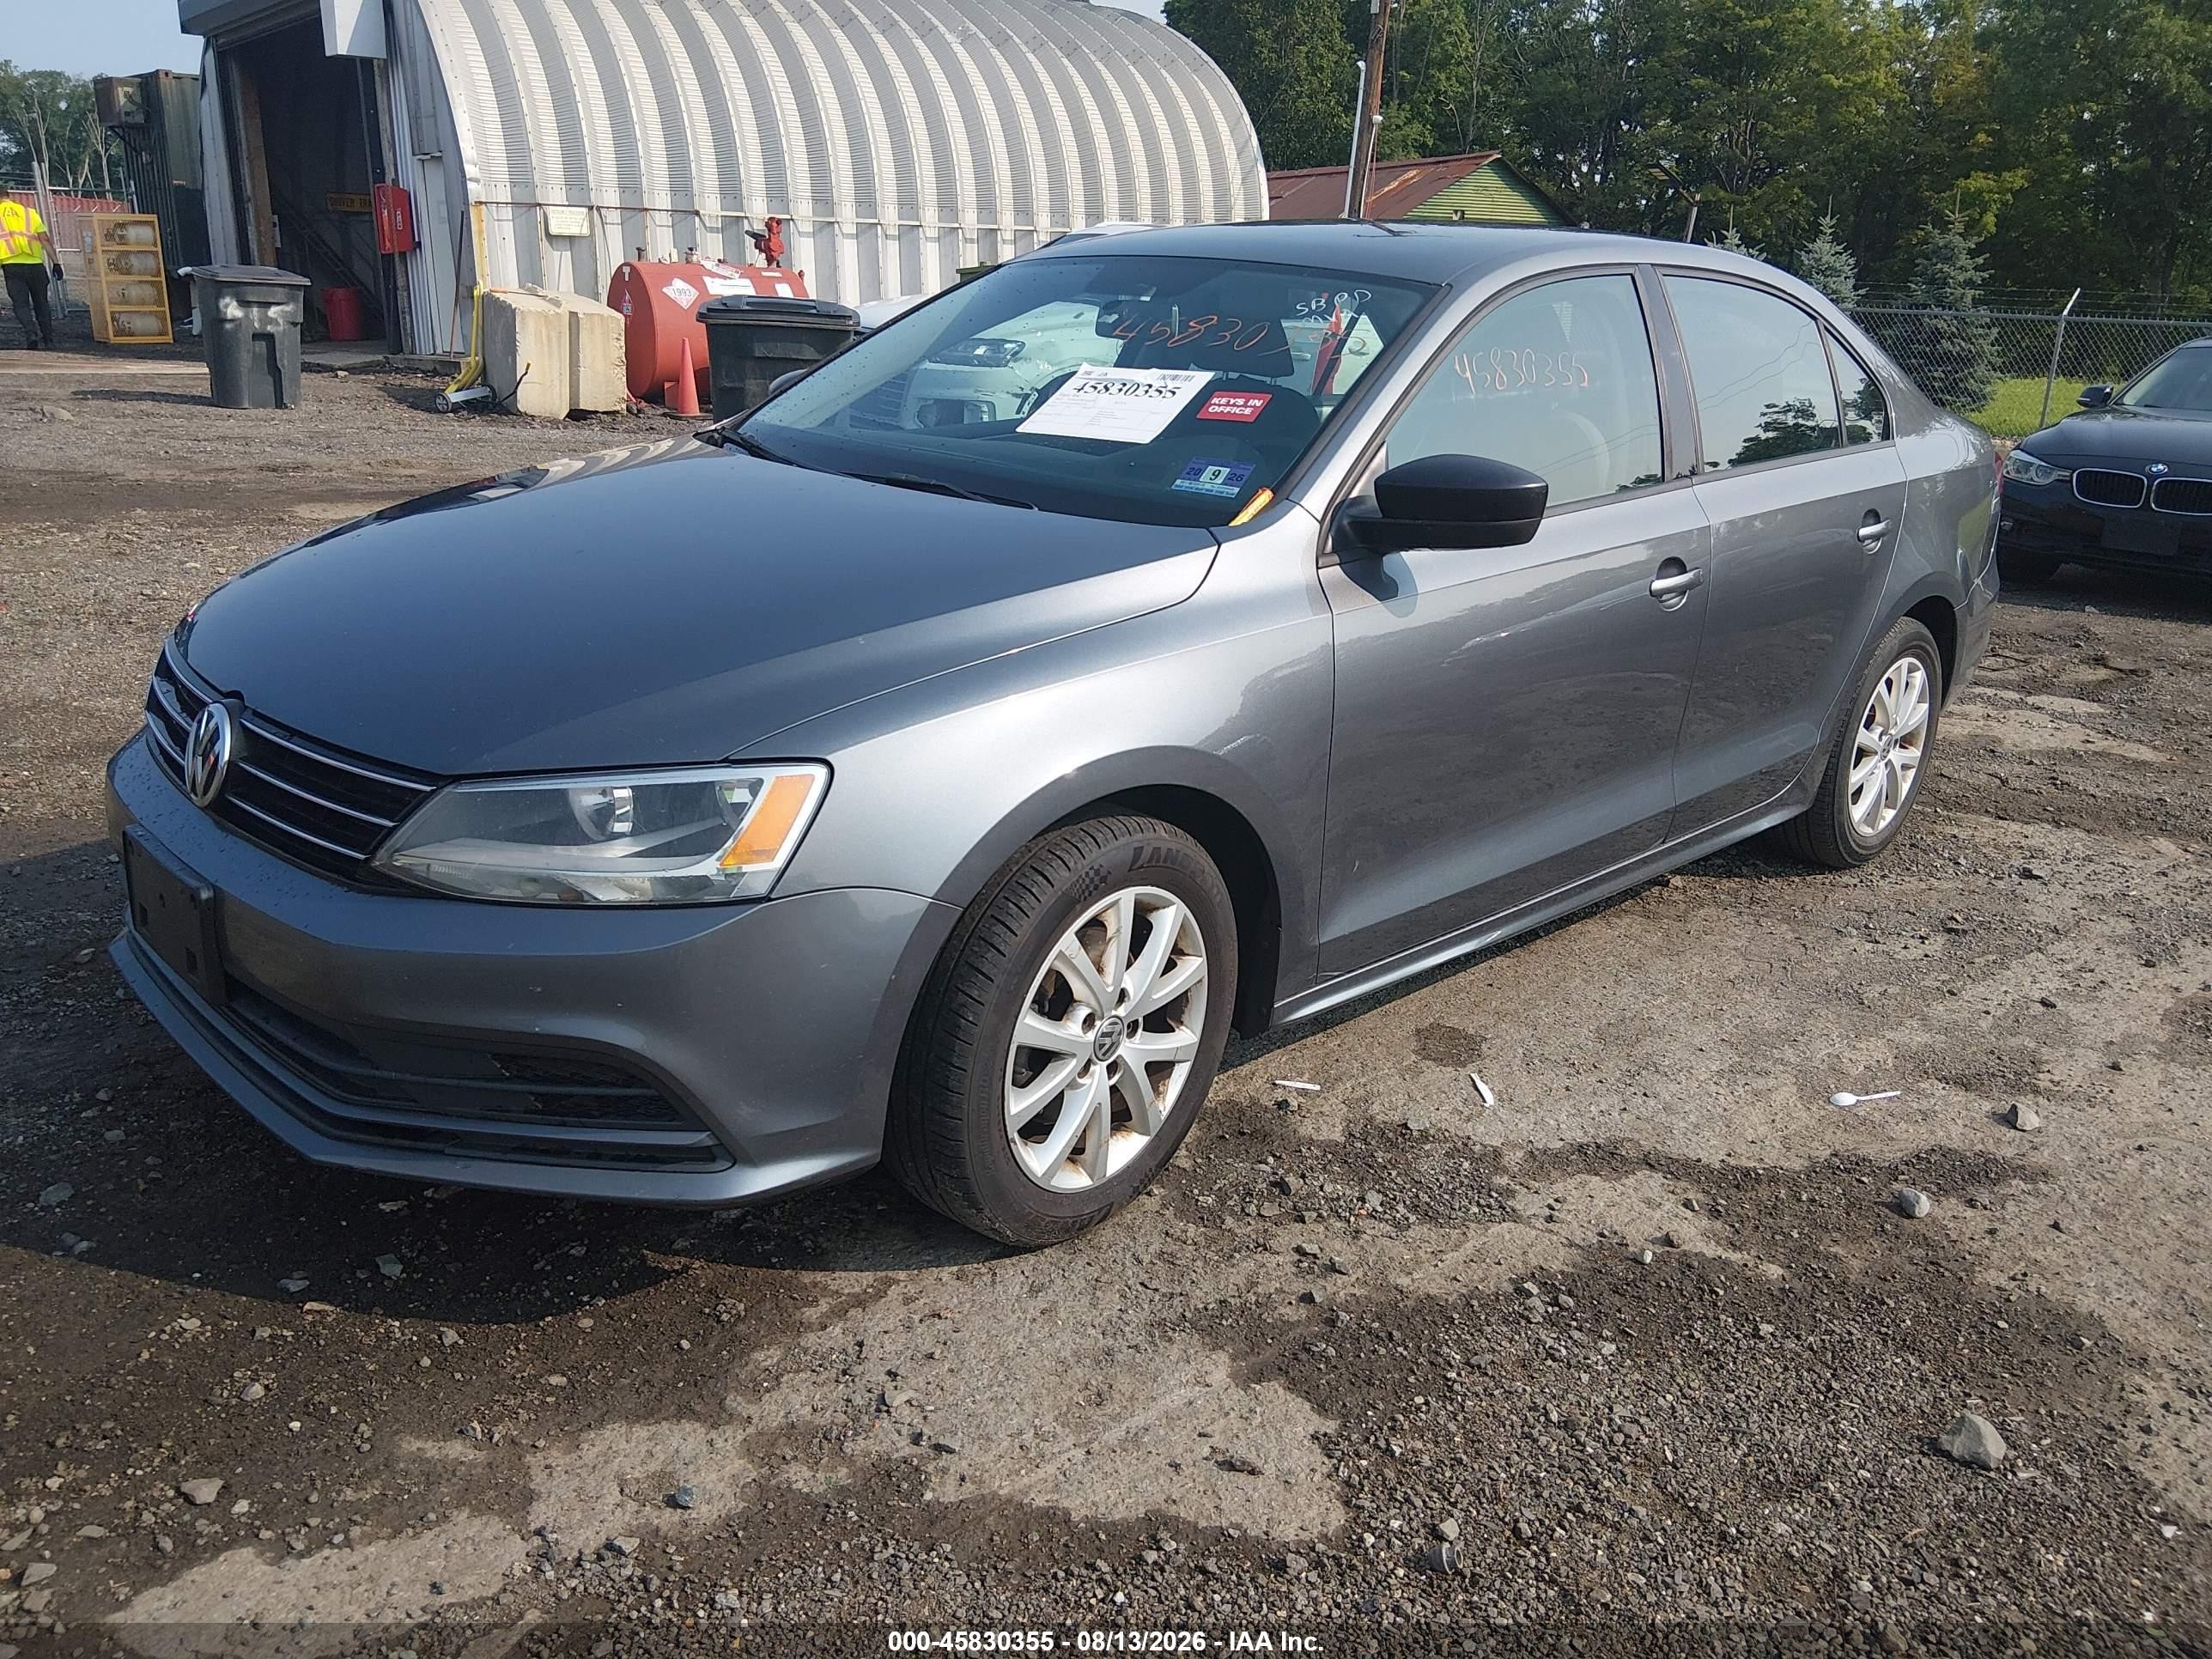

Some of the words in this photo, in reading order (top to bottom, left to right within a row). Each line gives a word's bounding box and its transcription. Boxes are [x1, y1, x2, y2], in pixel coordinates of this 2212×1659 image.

[672, 288, 692, 298] 1993
[1454, 347, 1588, 395] 45830355
[1073, 380, 1182, 399] 45830355
[1208, 406, 1254, 415] OFFICE
[1186, 467, 1202, 476] 20
[1209, 469, 1221, 481] 9
[1228, 472, 1245, 482] 26
